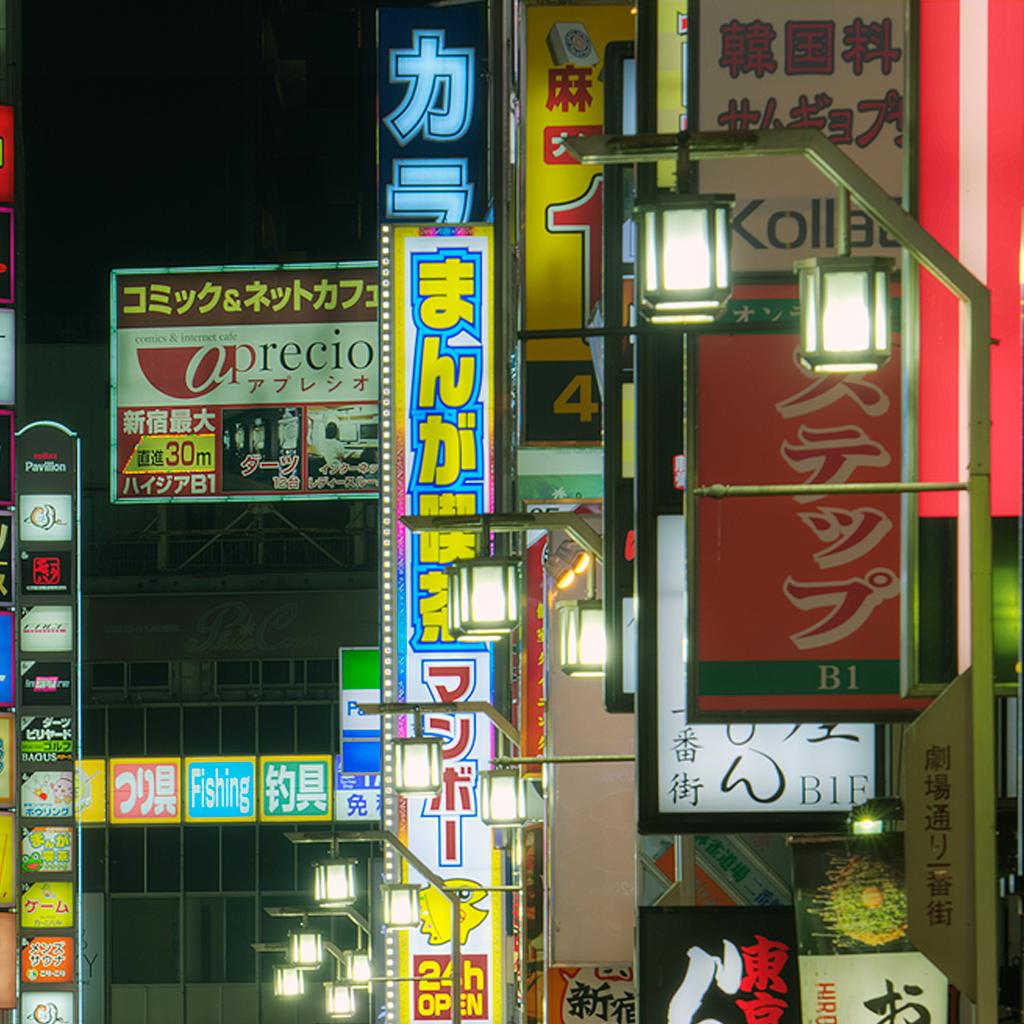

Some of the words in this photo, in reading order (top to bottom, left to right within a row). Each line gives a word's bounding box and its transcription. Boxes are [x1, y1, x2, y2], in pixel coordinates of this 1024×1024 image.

[718, 17, 903, 79] 韓国料
[545, 63, 594, 113] 麻
[134, 333, 168, 345] comics
[169, 333, 179, 343] &
[180, 331, 218, 343] internet
[219, 331, 239, 342] cafe
[185, 328, 375, 393] aprecio
[246, 374, 370, 395] アプレシオ
[552, 374, 599, 423] 4
[122, 408, 216, 436] 新宿最大
[25, 460, 67, 473] Pavilion
[137, 440, 212, 467] 直進30m
[239, 454, 301, 477] ダーツ
[122, 473, 216, 496] ハイジアB1
[272, 475, 301, 490] 12台
[775, 344, 902, 651] ステップ
[817, 664, 860, 691] B1
[22, 752, 58, 762] BAGUS
[115, 763, 177, 816] つり具
[191, 767, 251, 814] Fishing
[265, 763, 328, 814] 釣具
[798, 774, 869, 806] B1F
[28, 831, 70, 849] まんが
[923, 744, 954, 927] 劇場通り一番街
[23, 899, 71, 915] ゲーム
[28, 941, 66, 954] メンズ
[28, 954, 66, 967] サウナ
[418, 993, 483, 1017] OPEN
